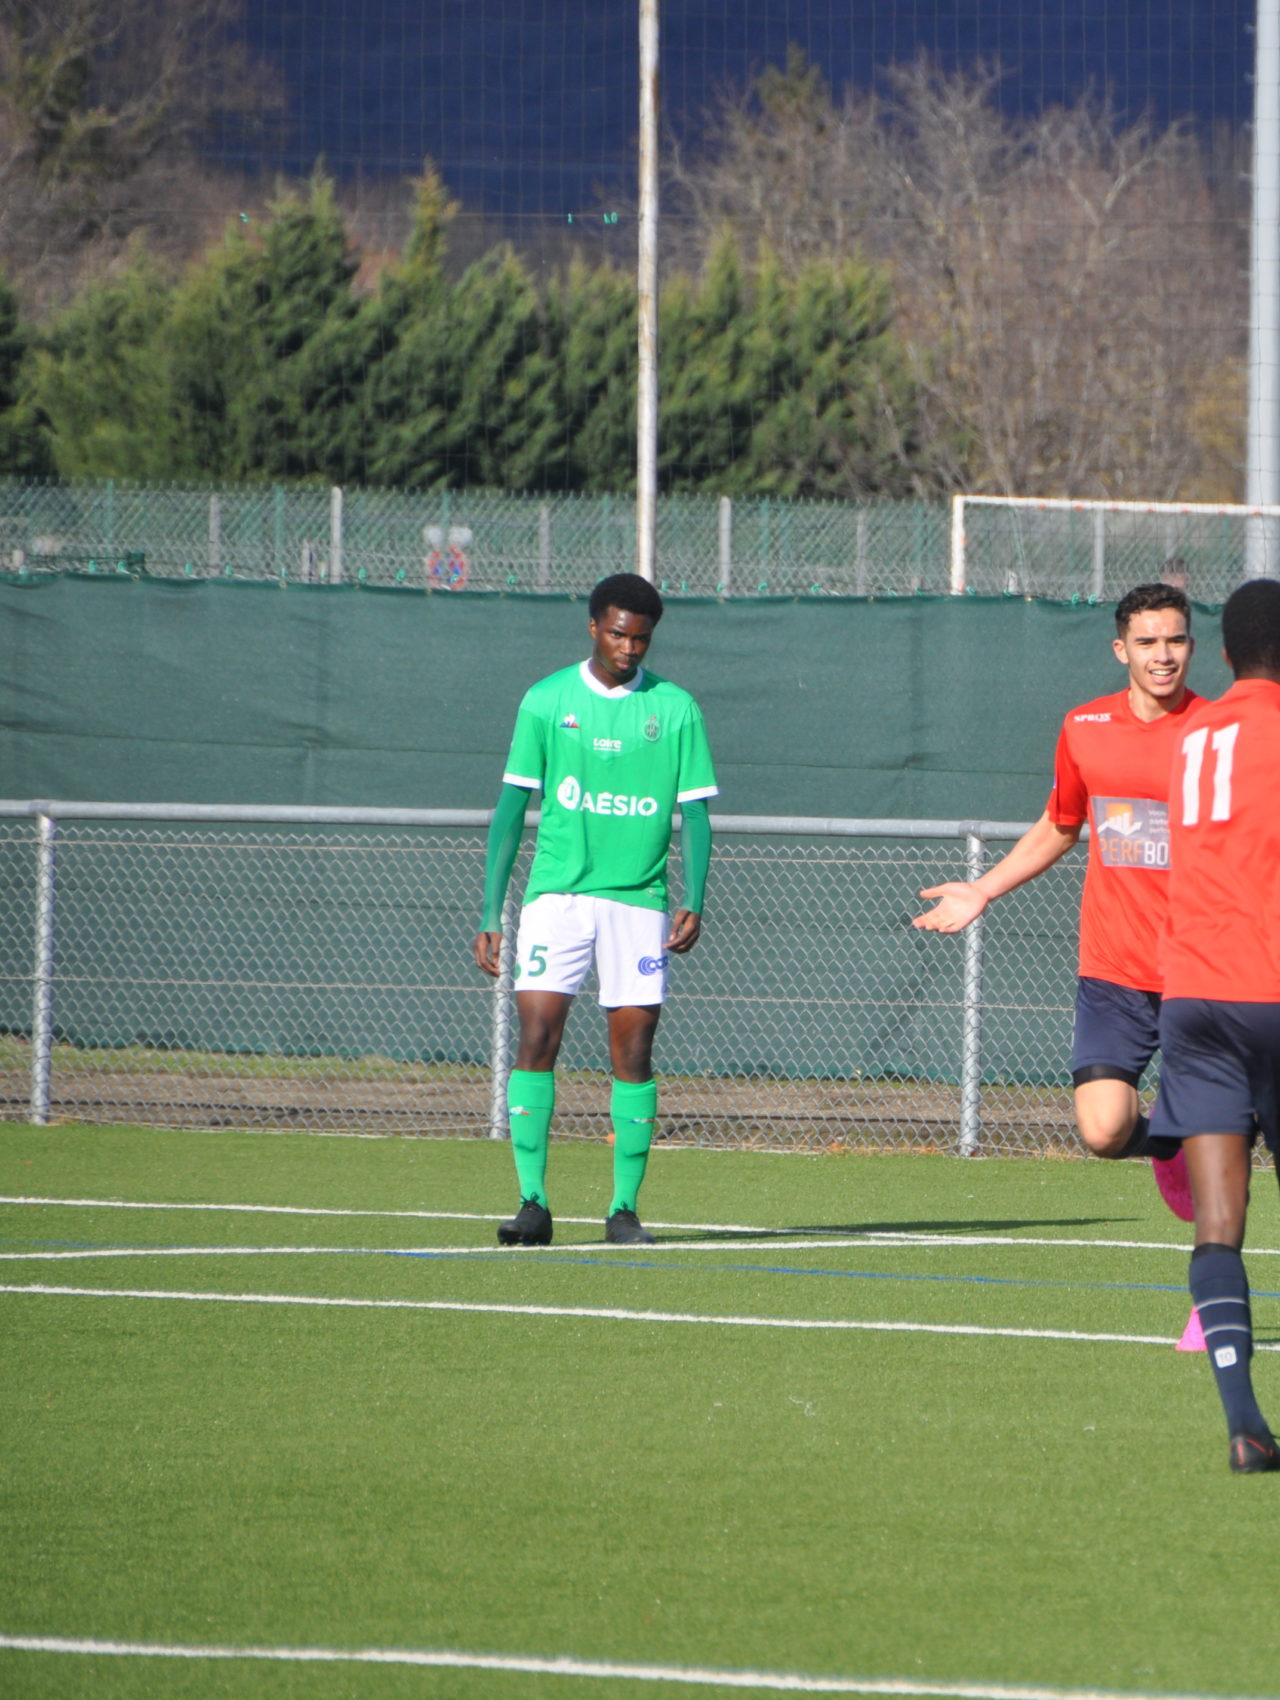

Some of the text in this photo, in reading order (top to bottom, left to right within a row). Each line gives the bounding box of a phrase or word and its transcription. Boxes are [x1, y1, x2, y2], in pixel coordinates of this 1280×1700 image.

[1181, 721, 1240, 826] 11
[1099, 838, 1168, 865] PERFBO
[527, 944, 548, 977] 5
